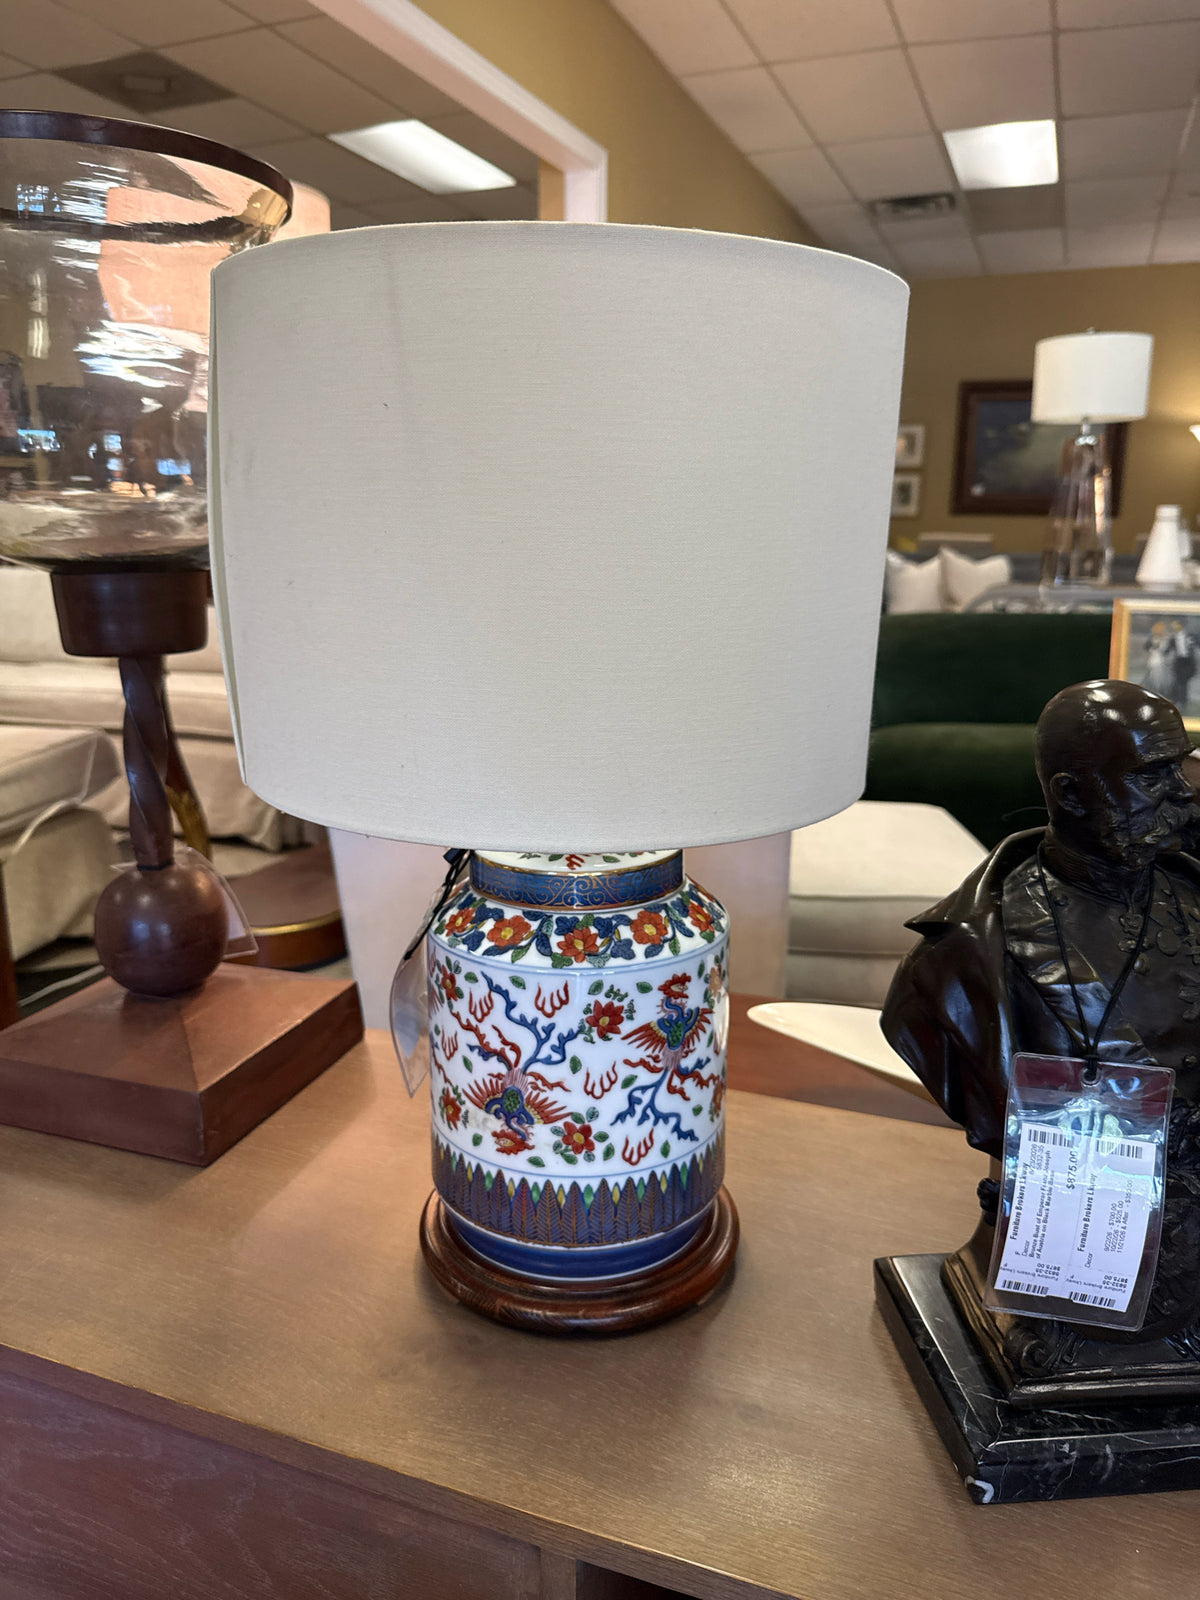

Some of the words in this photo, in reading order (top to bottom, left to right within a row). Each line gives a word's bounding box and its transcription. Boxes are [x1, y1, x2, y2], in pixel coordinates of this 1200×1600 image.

[1066, 1150, 1079, 1190] $875.00
[1015, 1184, 1025, 1211] Brokers
[1029, 1239, 1037, 1257] Bronze
[1037, 1192, 1045, 1217] Emperor
[1043, 1150, 1051, 1173] Joseph
[1045, 1187, 1053, 1206] Marble
[1042, 1208, 1050, 1224] Black
[1083, 1197, 1093, 1222] Brokers
[1108, 1202, 1117, 1226] $700.00
[1010, 1211, 1022, 1240] Furniture
[1042, 1224, 1047, 1232] on
[1110, 1229, 1120, 1252] 10/22/26
[1115, 1200, 1124, 1224] $525.00
[1022, 1240, 1030, 1256] Decor
[1037, 1233, 1045, 1253] Austria
[1078, 1223, 1089, 1252] Furniture
[1104, 1231, 1113, 1252] 9/22/26
[1117, 1230, 1126, 1253] 11/21/26
[1084, 1252, 1093, 1268] Decor
